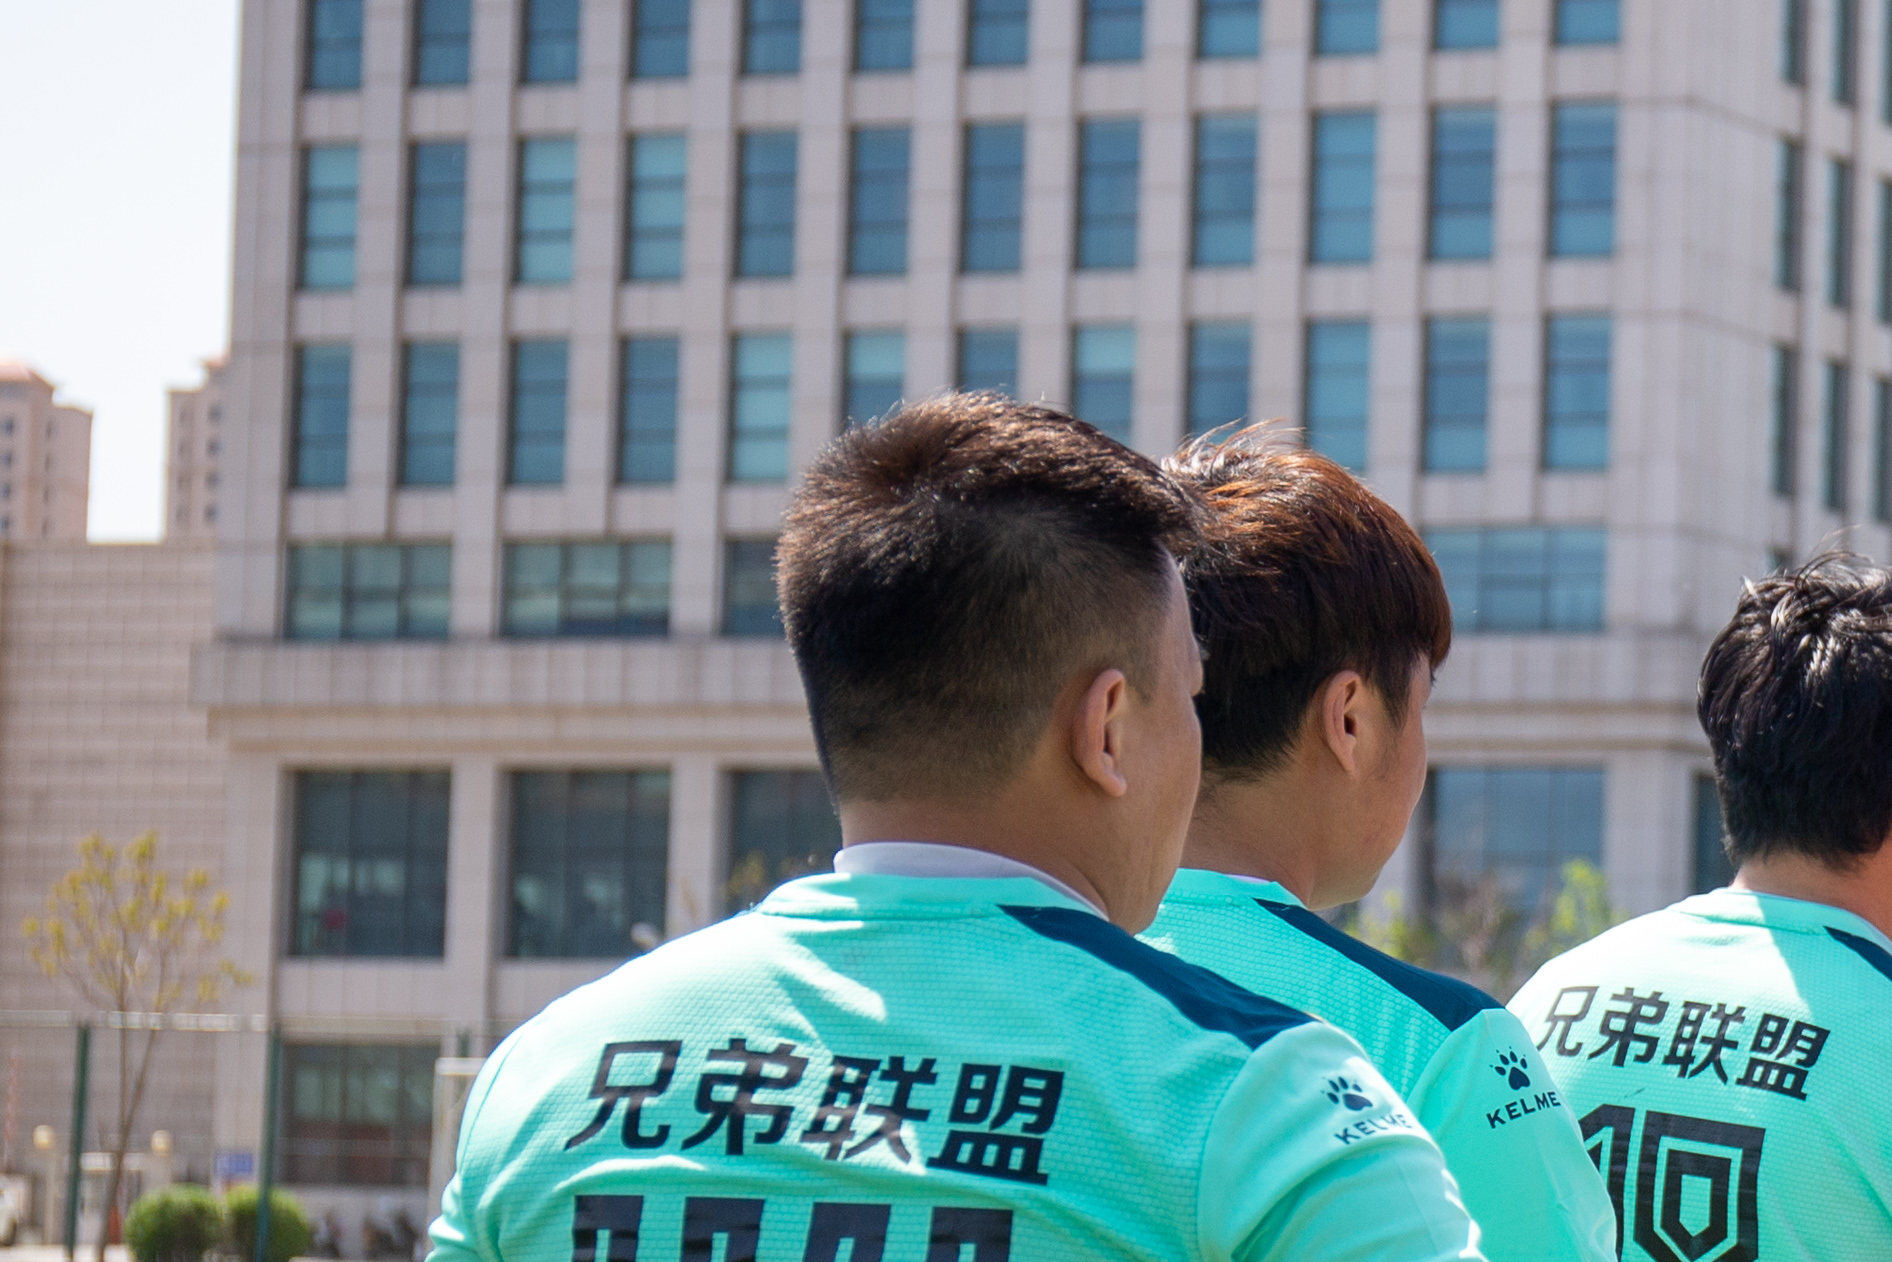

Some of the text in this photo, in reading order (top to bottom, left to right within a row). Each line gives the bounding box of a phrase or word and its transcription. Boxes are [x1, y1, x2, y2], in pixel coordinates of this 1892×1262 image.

[1537, 985, 1831, 1101] 兄弟联盟
[564, 1037, 1065, 1186] 兄弟联盟
[1334, 1114, 1413, 1145] KELME
[1486, 1091, 1561, 1129] KELME
